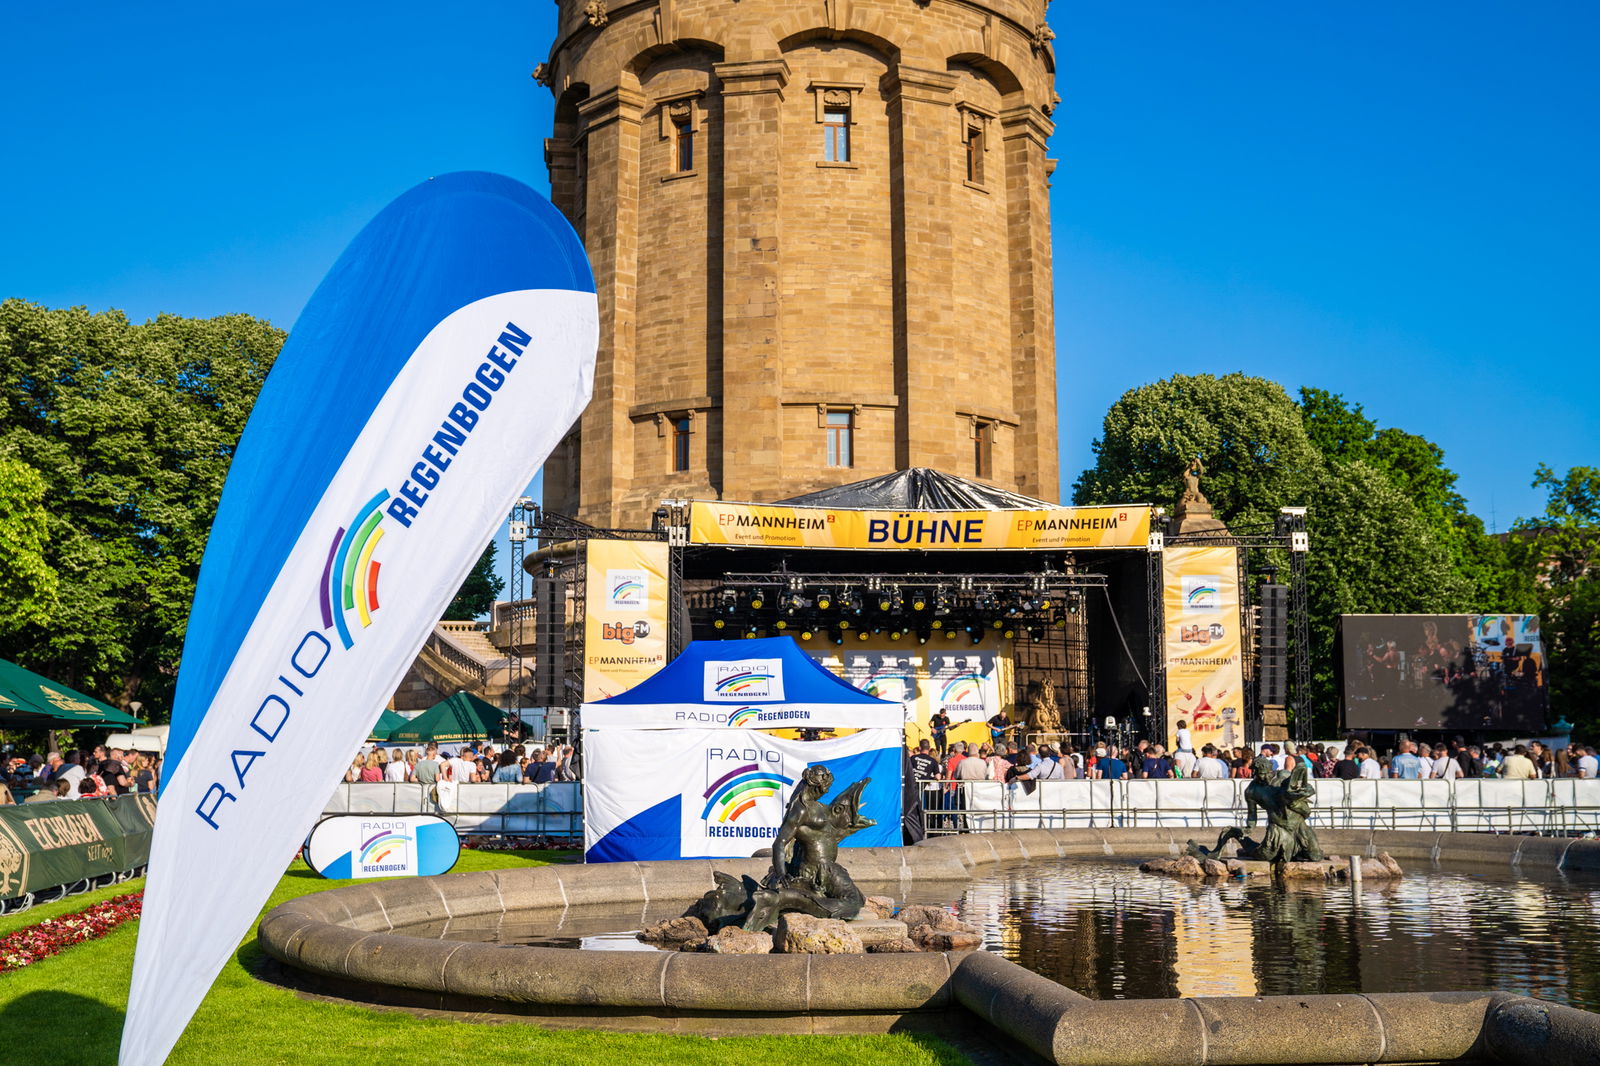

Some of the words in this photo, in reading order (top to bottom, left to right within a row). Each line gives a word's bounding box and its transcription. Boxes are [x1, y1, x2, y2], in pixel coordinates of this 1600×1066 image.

[868, 514, 984, 544] BÜHNE
[765, 534, 796, 542] Promotion
[1061, 536, 1091, 544] Promotion
[195, 630, 331, 831] RADIO
[387, 321, 533, 529] REGENBOGEN
[675, 711, 727, 723] RADIO
[758, 710, 810, 721] REGENBOGEN
[710, 748, 781, 763] RADIO
[24, 812, 104, 851] EICHBAUM
[363, 821, 406, 830] RADIO
[709, 826, 781, 838] REGENBOGEN
[363, 864, 406, 872] REGENBOGEN
